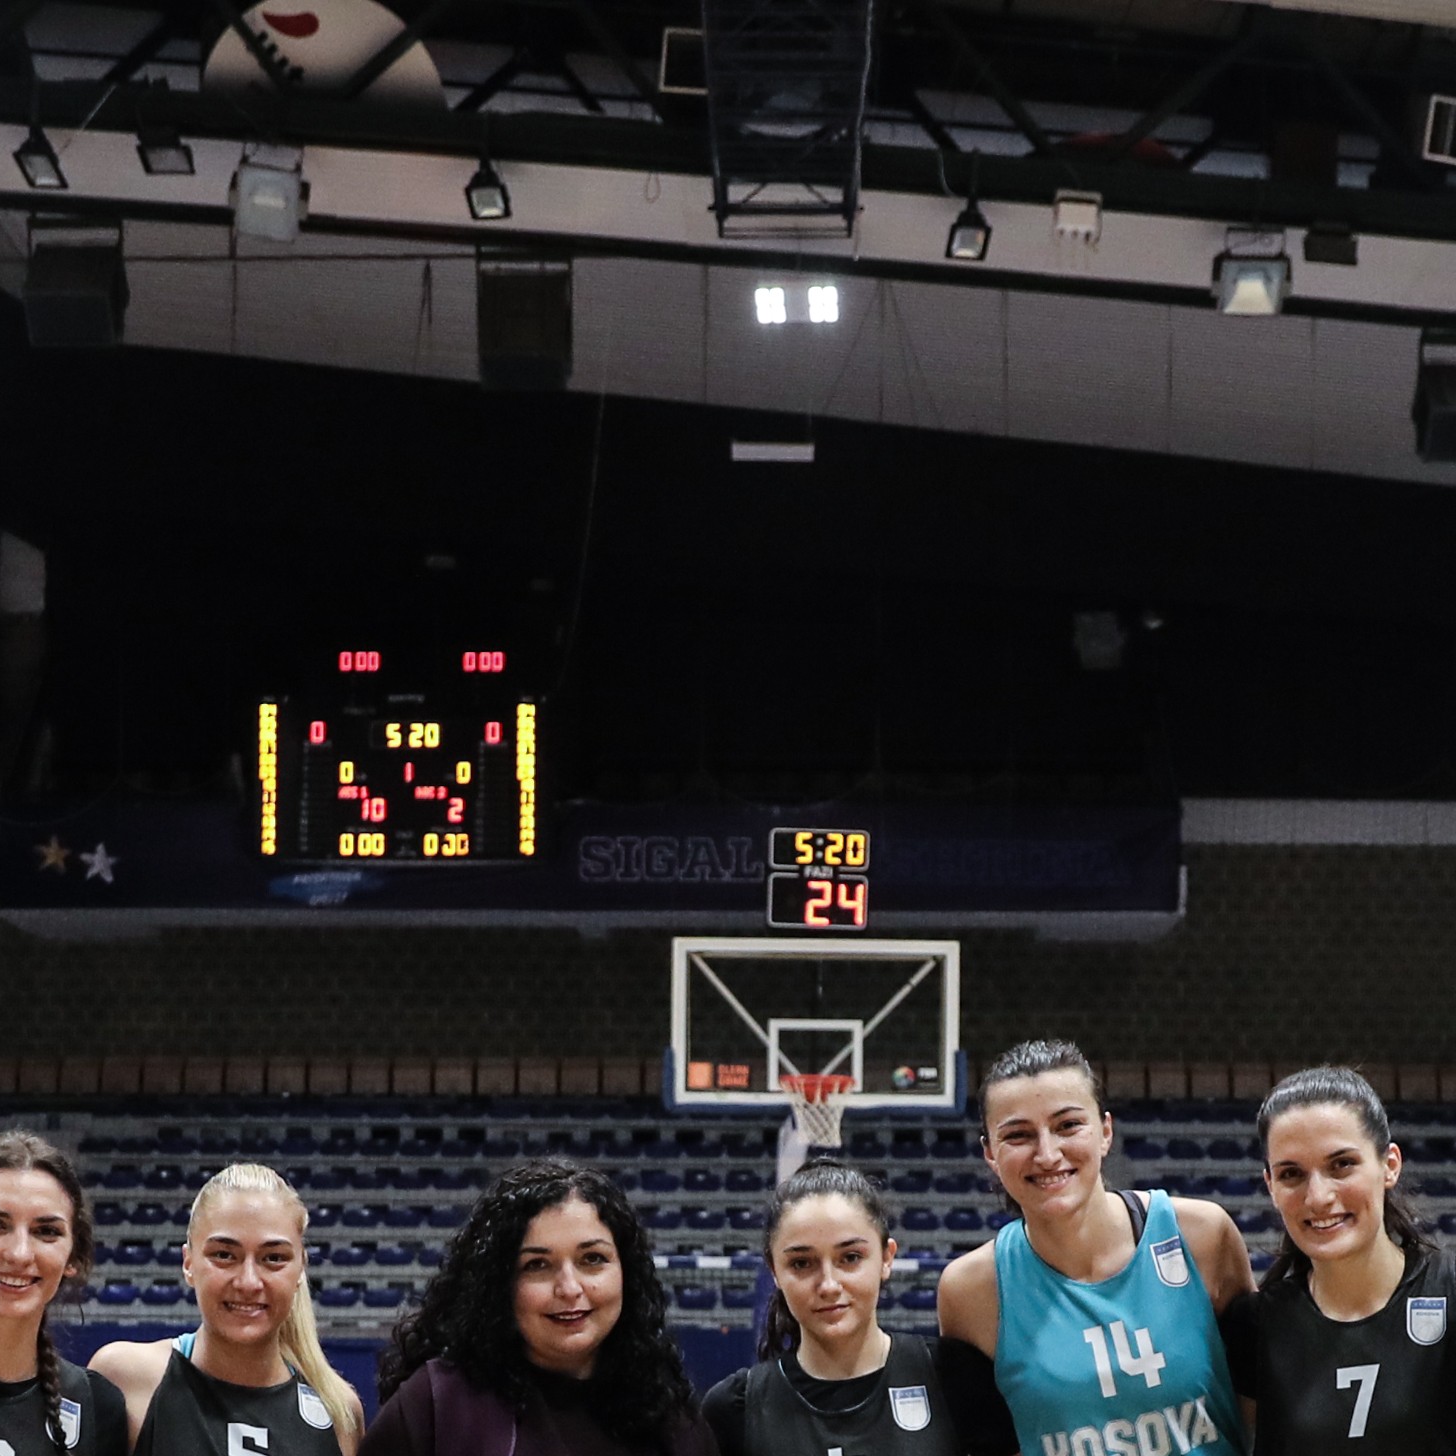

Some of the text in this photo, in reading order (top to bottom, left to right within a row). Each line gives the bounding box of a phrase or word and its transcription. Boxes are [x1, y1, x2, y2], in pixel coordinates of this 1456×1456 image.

[309, 720, 327, 744] 0
[484, 721, 503, 745] 0
[339, 760, 355, 785] 0
[455, 760, 472, 785] 0
[360, 797, 388, 822] 10
[446, 797, 465, 823] 2
[579, 835, 766, 883] SIGAL
[794, 831, 866, 867] 5:20
[804, 879, 866, 927] 24
[1082, 1319, 1167, 1399] 14
[1335, 1362, 1381, 1439] 7
